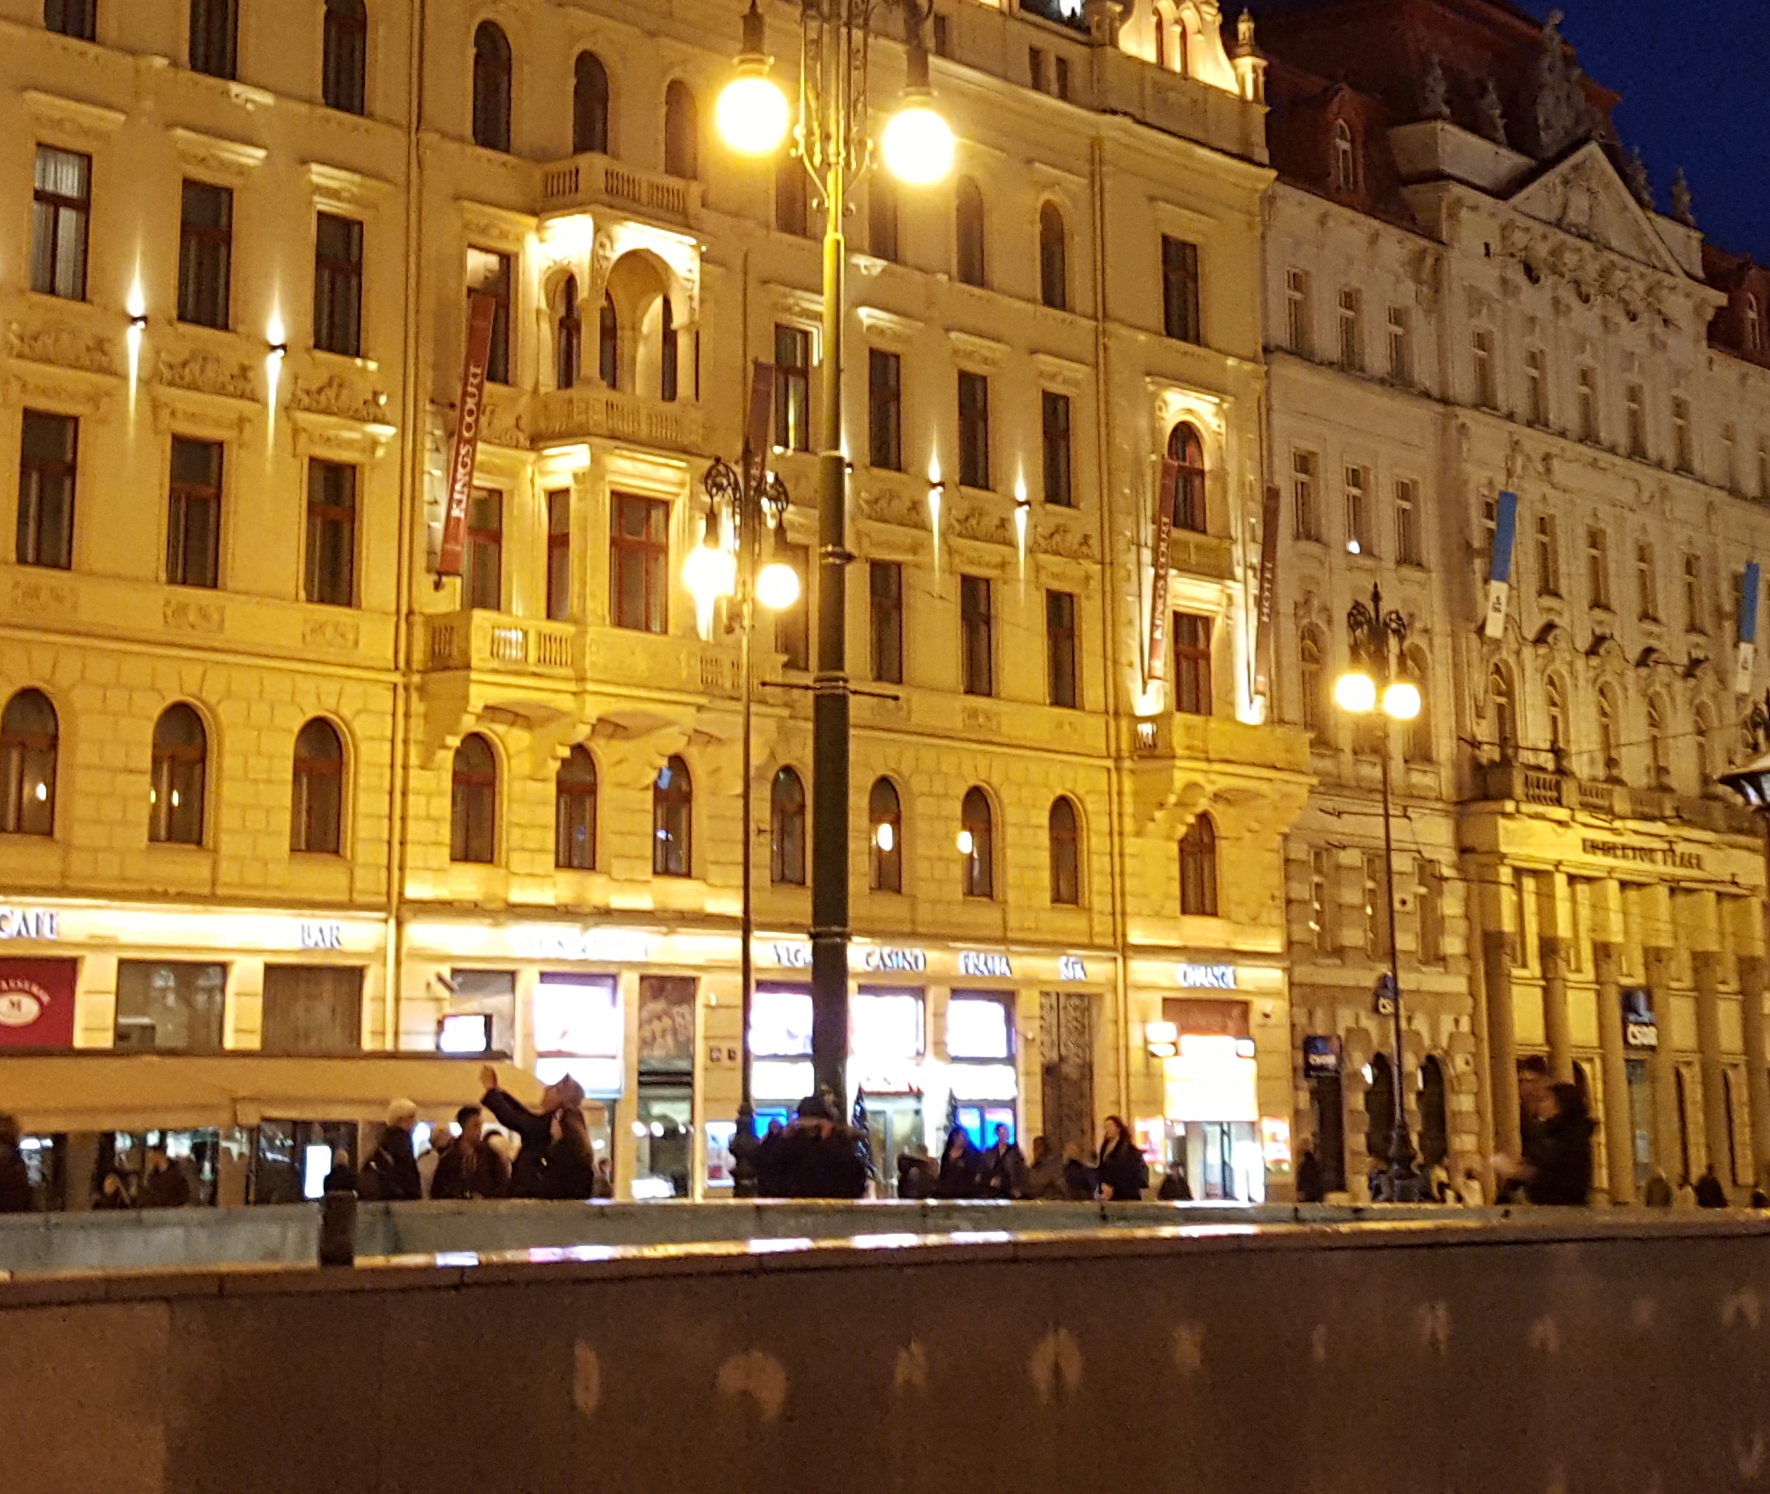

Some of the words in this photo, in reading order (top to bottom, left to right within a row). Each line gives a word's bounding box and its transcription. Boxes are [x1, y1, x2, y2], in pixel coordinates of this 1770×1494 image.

[450, 442, 473, 518] KINGS
[462, 364, 482, 438] COURT
[301, 922, 341, 949] BAR
[865, 947, 927, 973] CASINO
